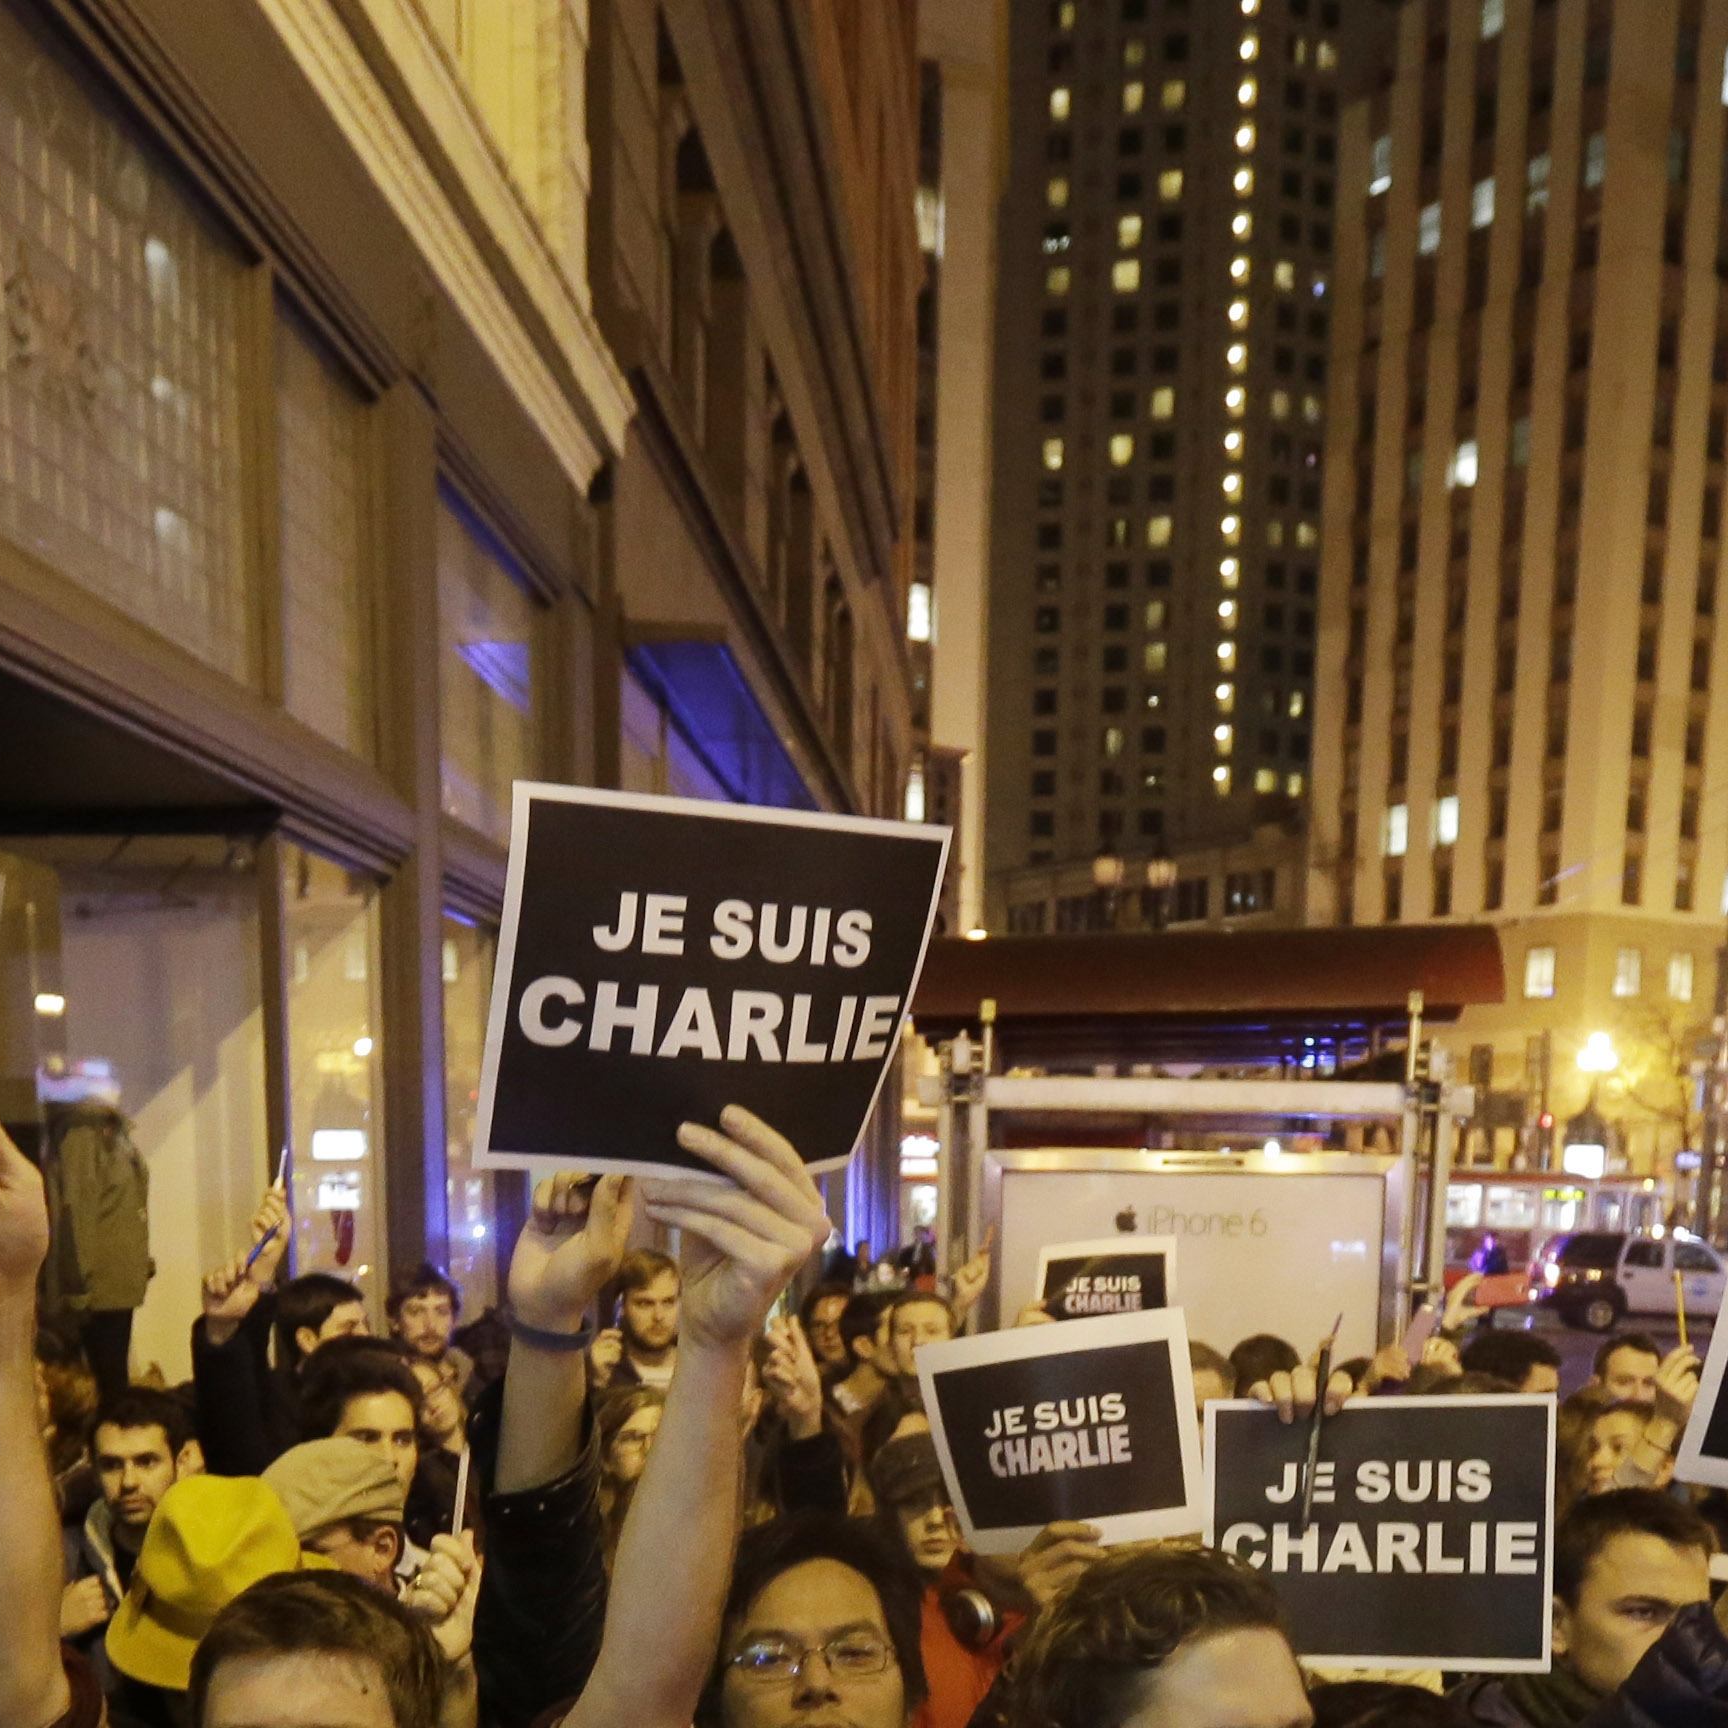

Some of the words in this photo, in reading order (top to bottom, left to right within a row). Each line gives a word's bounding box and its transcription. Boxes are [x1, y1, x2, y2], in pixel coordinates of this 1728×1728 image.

[592, 890, 688, 956] JE
[709, 899, 873, 968] SUIS
[518, 974, 901, 1064] CHARLIE
[1147, 1203, 1244, 1236] iPhone
[1248, 1208, 1268, 1237] 6
[1064, 1292, 1143, 1314] CHARLIE
[1065, 1276, 1091, 1293] JE
[1093, 1274, 1142, 1293] SUIS
[984, 1406, 1028, 1439] JE
[1033, 1392, 1127, 1431] SUIS
[988, 1423, 1133, 1479] CHARLIE
[1264, 1461, 1336, 1503] JE
[1354, 1458, 1493, 1503] SUIS
[1221, 1521, 1538, 1575] CHARLIE
